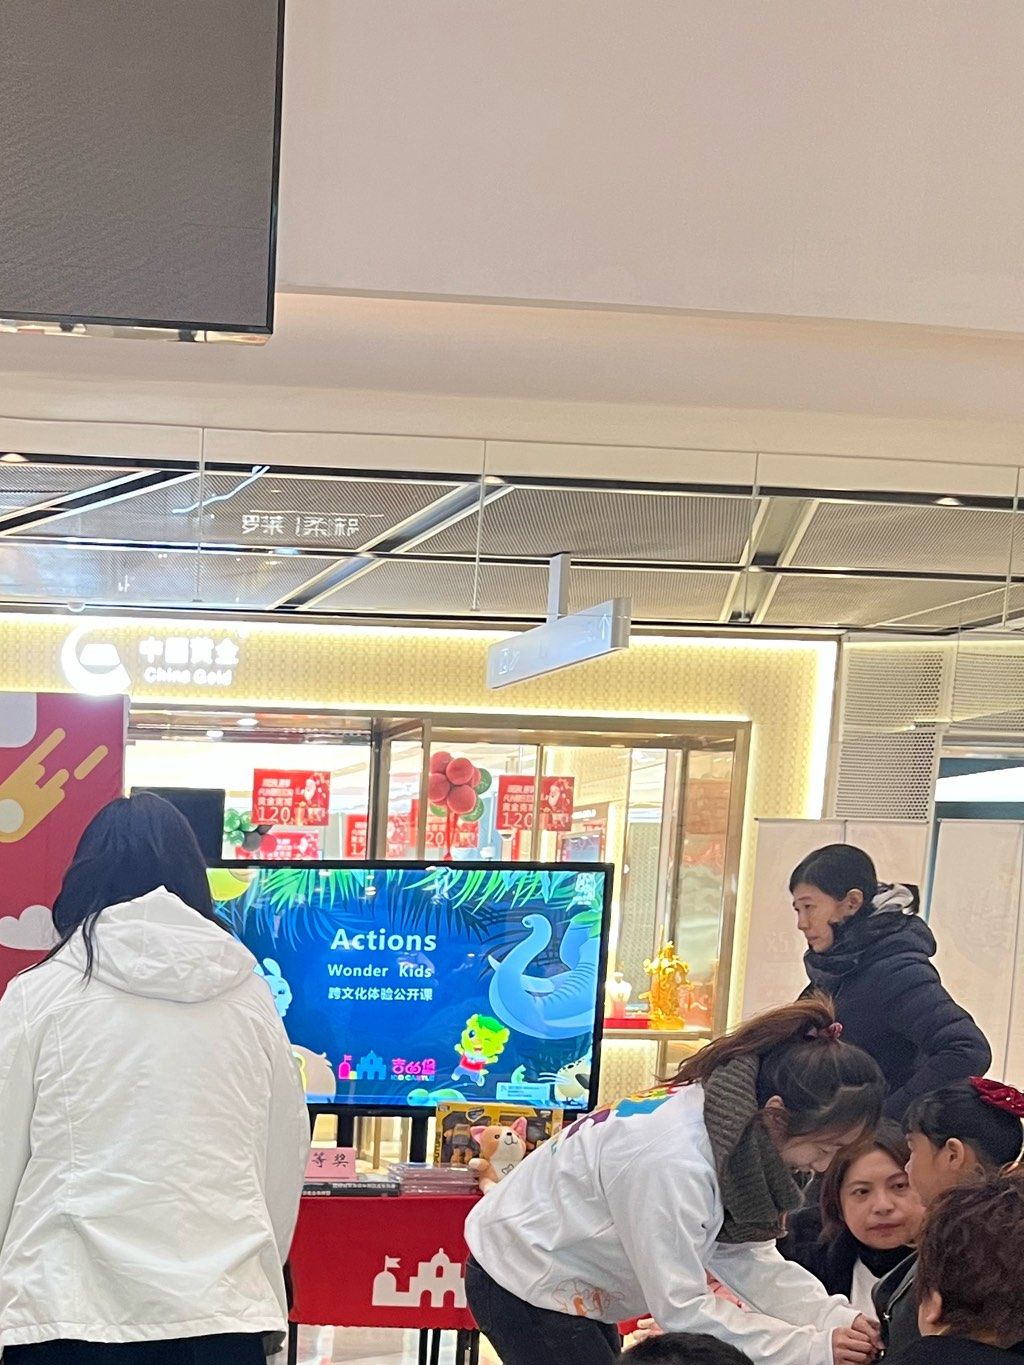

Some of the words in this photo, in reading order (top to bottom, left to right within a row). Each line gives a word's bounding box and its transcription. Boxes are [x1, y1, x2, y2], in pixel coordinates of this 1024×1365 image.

[258, 806, 291, 823] 120
[330, 927, 437, 952] Actions
[327, 963, 389, 977] Wonder
[399, 964, 433, 978] Kids
[327, 986, 433, 1001] 跨文化体验公开课
